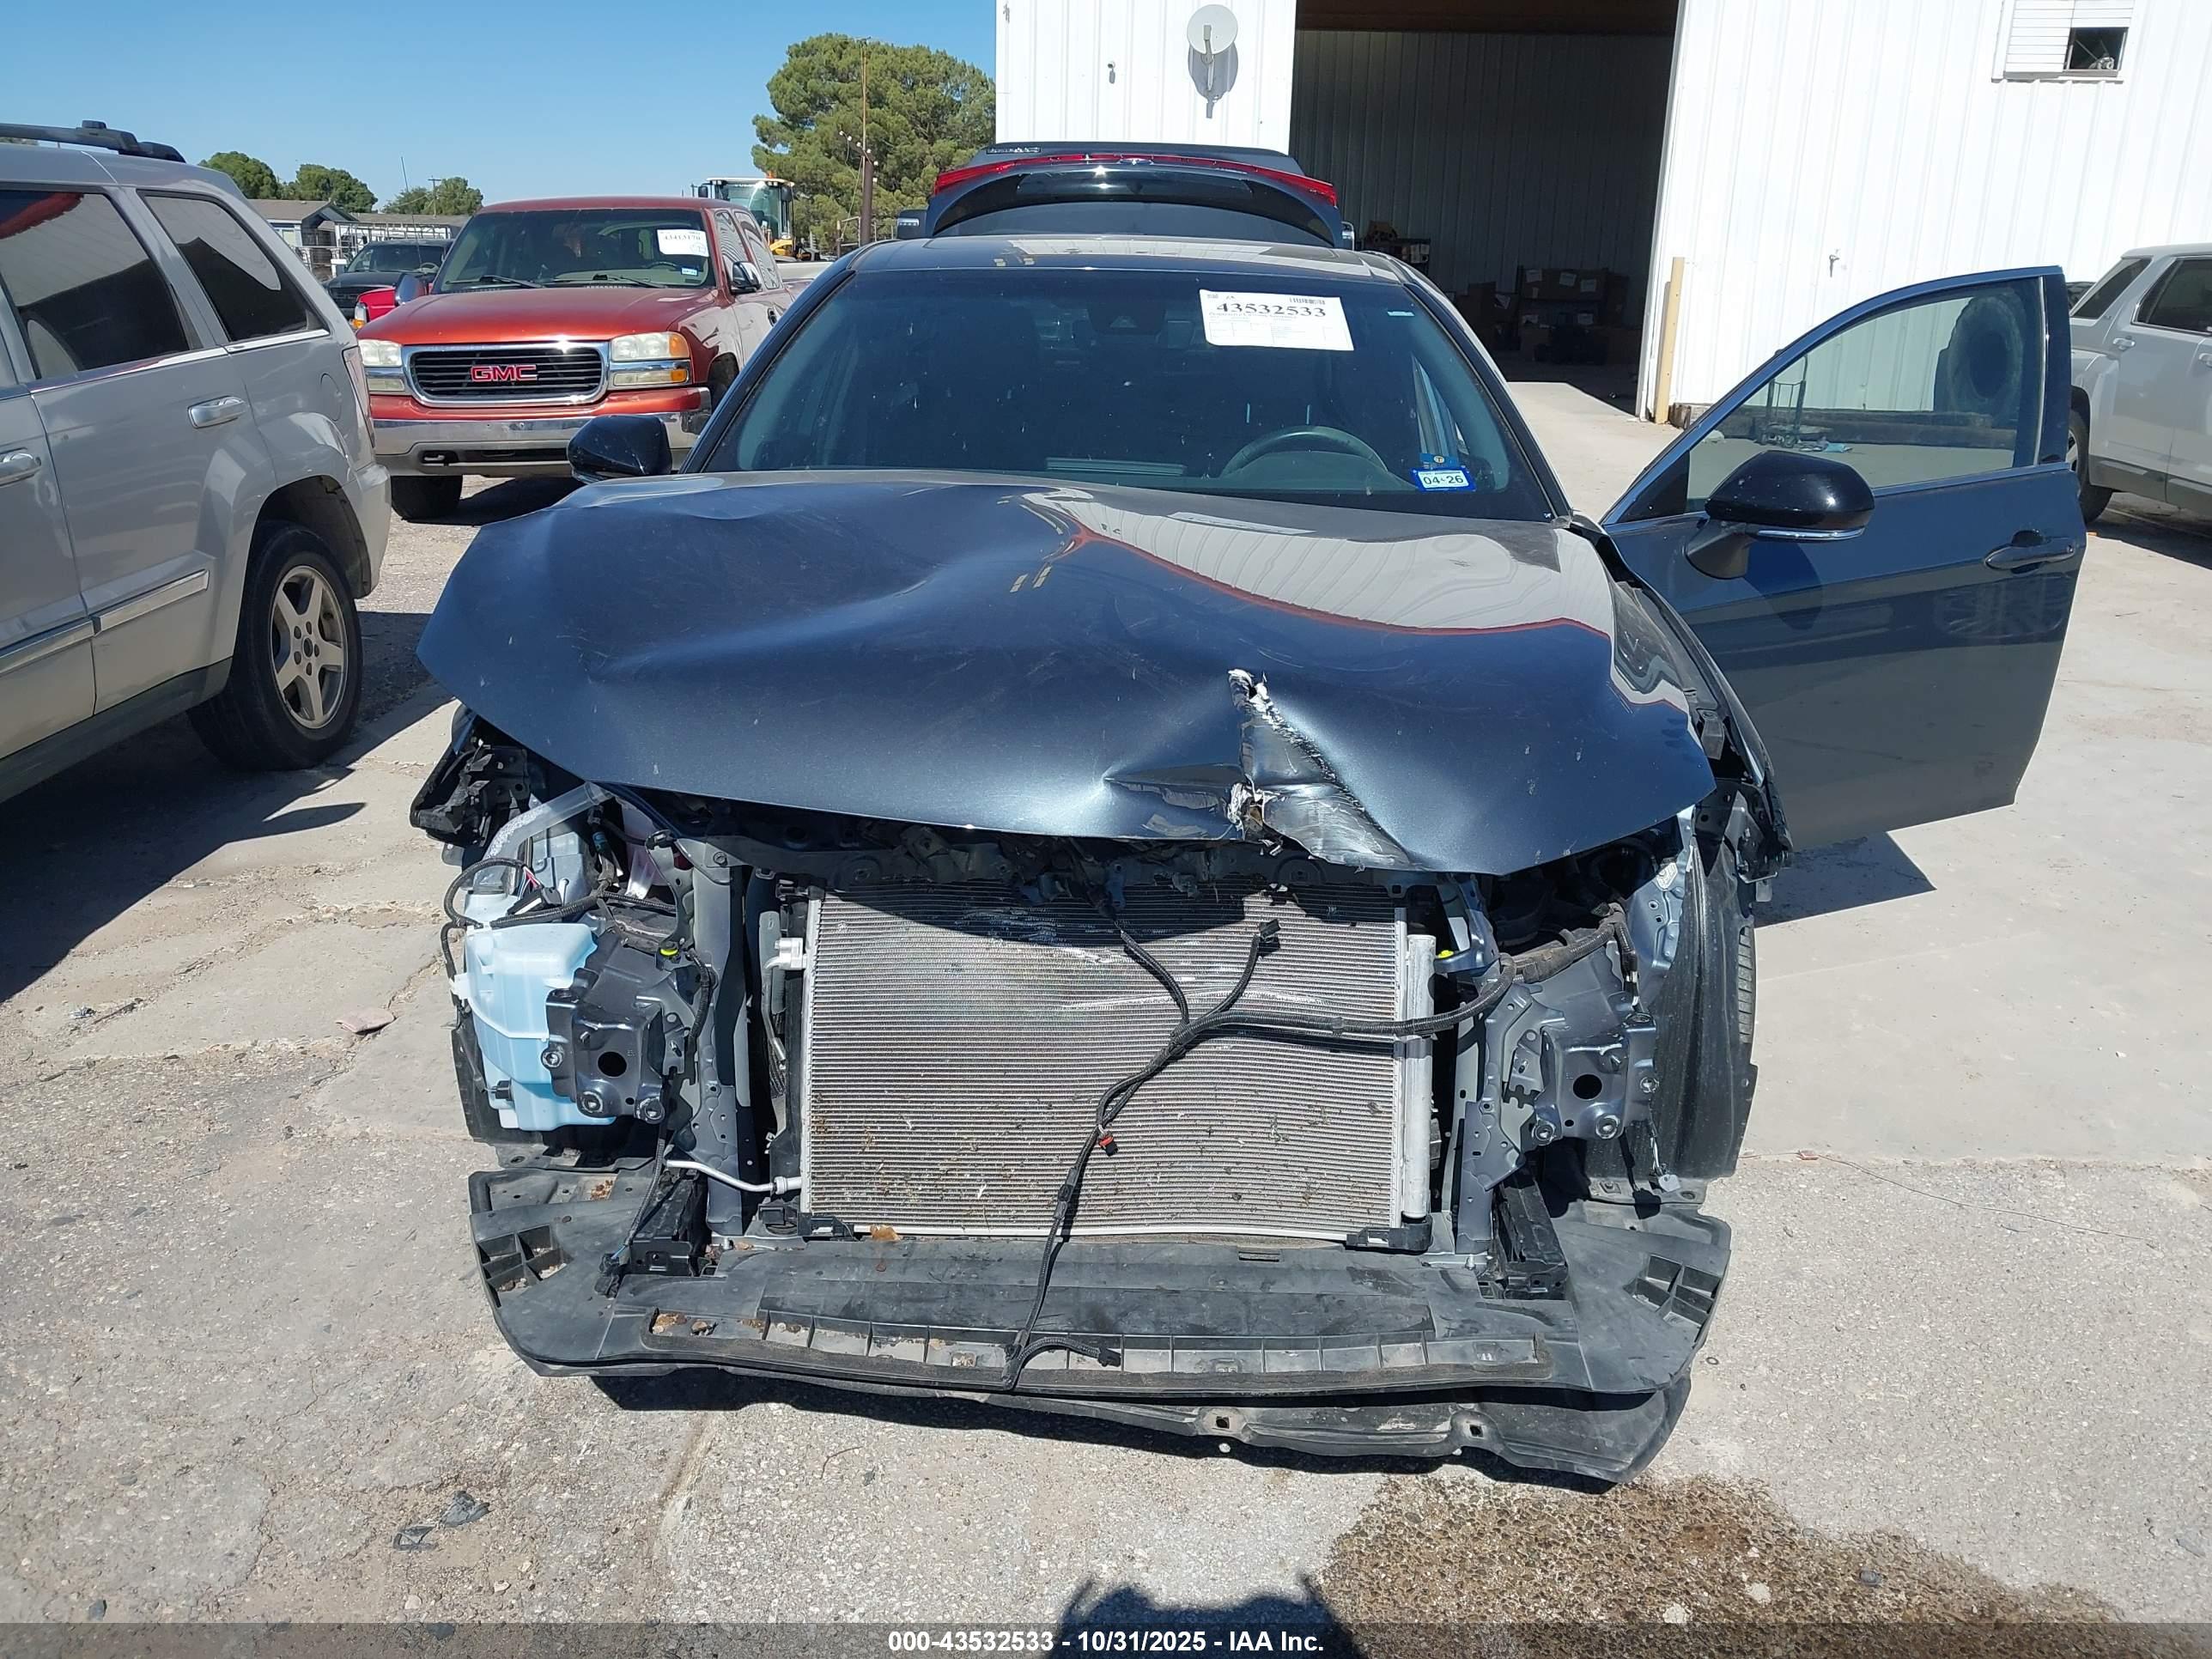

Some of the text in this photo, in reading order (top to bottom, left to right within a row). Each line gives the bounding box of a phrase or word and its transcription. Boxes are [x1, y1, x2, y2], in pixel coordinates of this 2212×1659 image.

[1217, 302, 1327, 318] 43532533
[471, 364, 538, 381] GMC
[1423, 475, 1464, 485] 04-26
